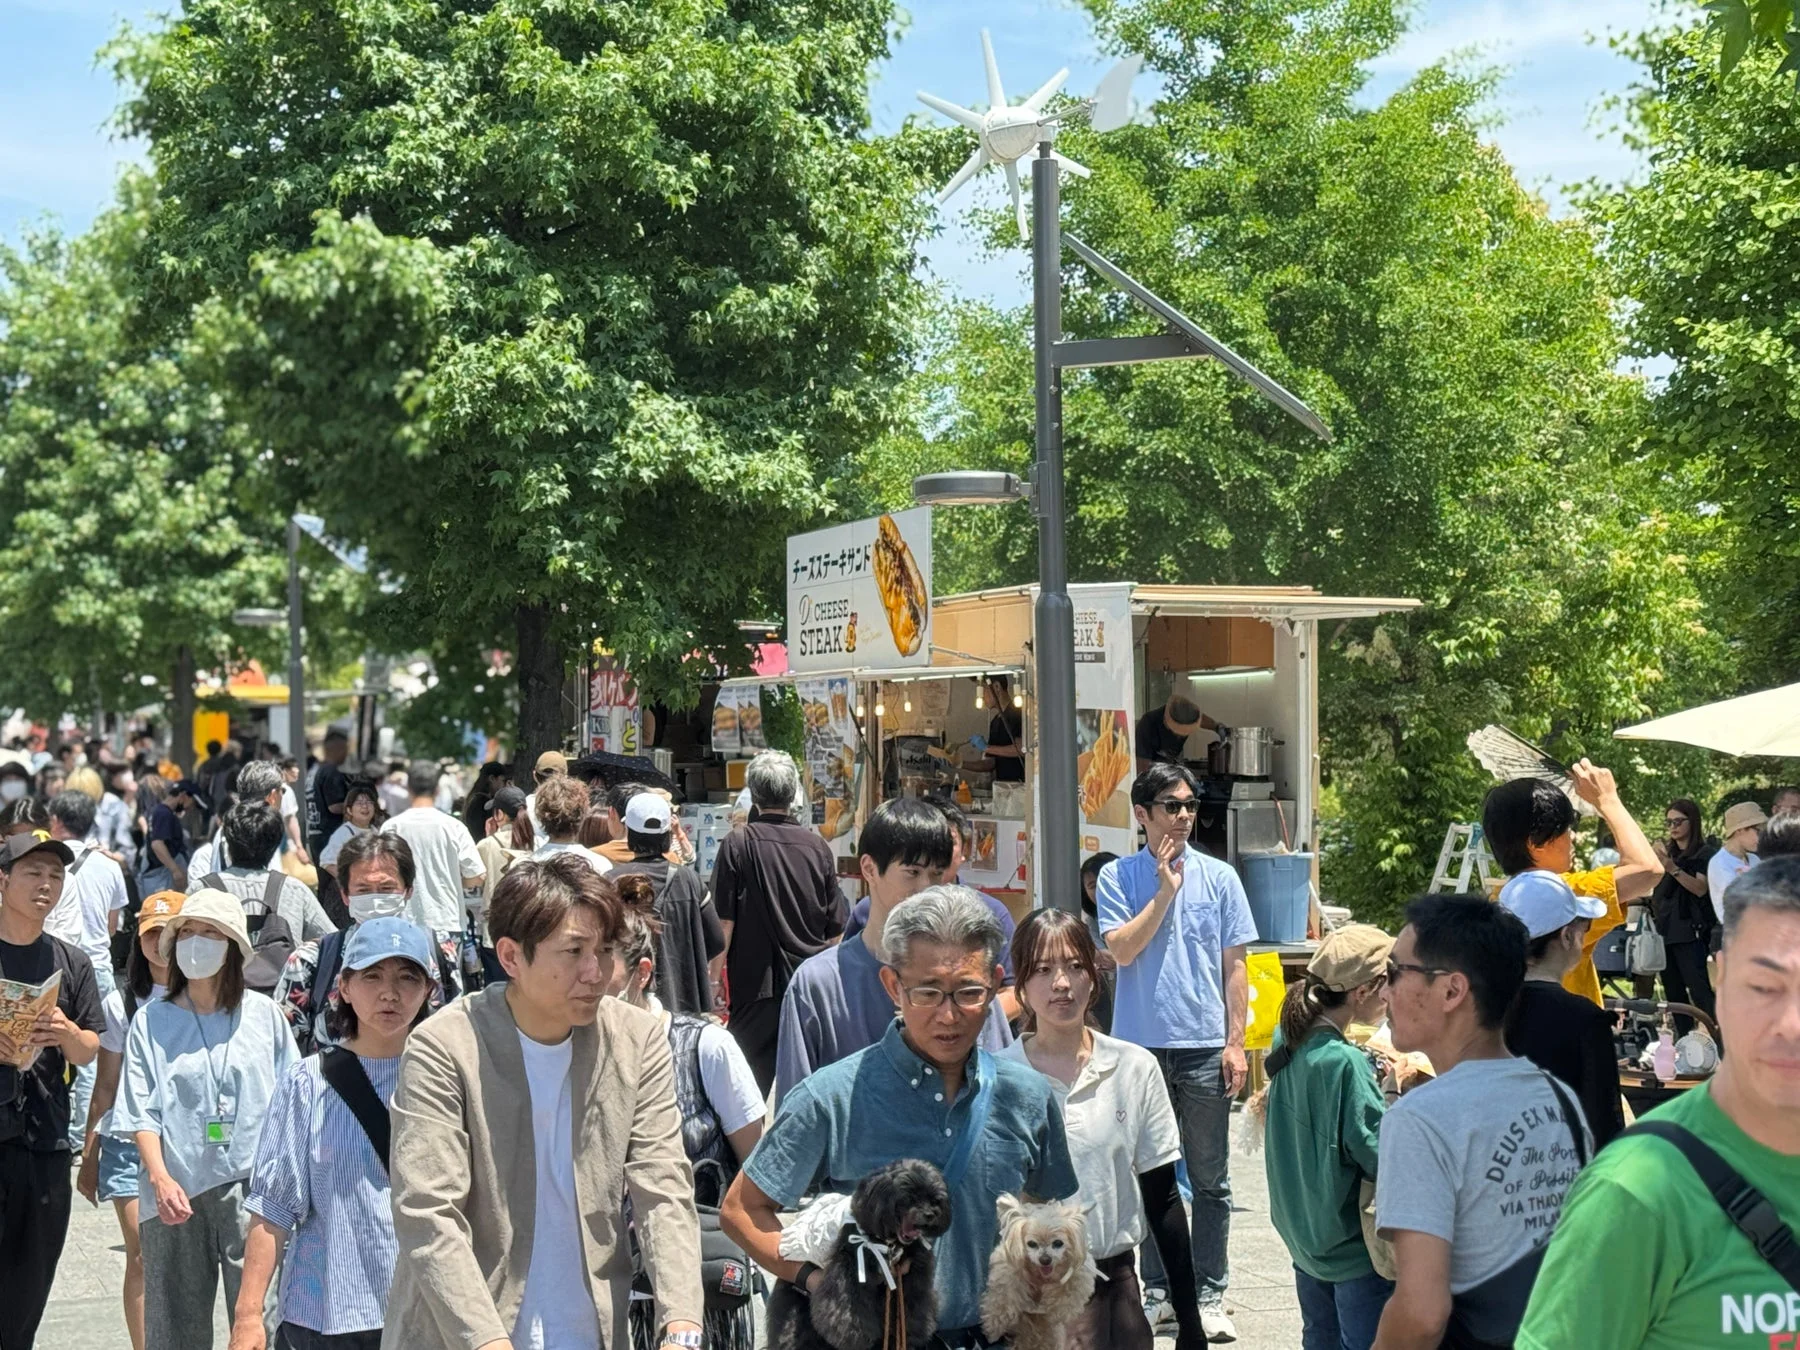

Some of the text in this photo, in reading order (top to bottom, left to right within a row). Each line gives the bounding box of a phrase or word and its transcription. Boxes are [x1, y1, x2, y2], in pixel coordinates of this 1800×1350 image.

[793, 544, 871, 584] チーズステーキサンド
[814, 599, 849, 622] CHEESE
[1074, 612, 1098, 625] HEESE
[800, 625, 843, 656] STEAK
[1074, 628, 1095, 647] EAK
[1485, 1121, 1526, 1184] DEUS
[1521, 1106, 1545, 1130] EX
[1504, 1179, 1524, 1195] OF
[1500, 1200, 1525, 1217] VIA
